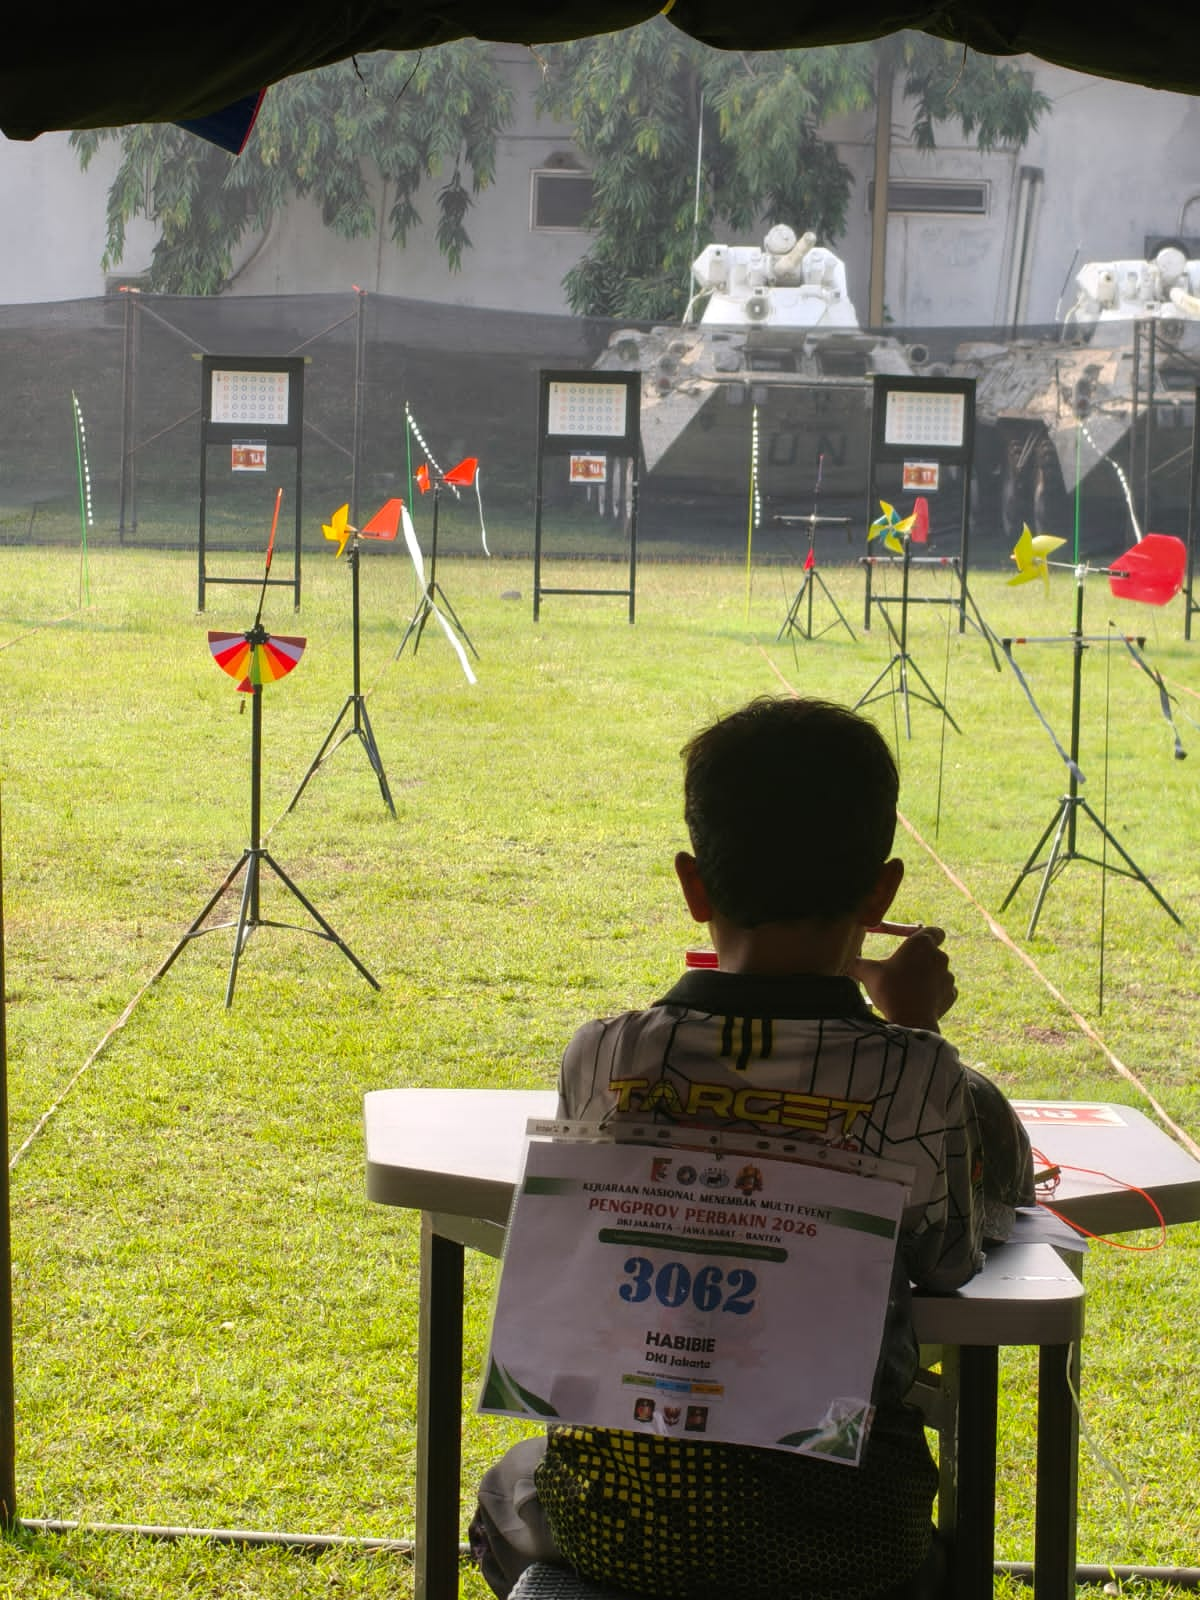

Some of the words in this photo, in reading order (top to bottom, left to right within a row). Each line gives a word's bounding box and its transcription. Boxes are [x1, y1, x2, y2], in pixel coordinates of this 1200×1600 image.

[768, 431, 848, 466] UN
[608, 1078, 873, 1133] TARGET
[583, 1182, 639, 1196] KEJUARAAN
[641, 1185, 697, 1203] NASIONAL
[699, 1194, 757, 1209] MENEMBAK
[760, 1200, 794, 1214] MULTI
[797, 1206, 832, 1221] EVENT
[588, 1197, 680, 1219] PENGPROV
[685, 1207, 767, 1229] PERBAKIN
[771, 1216, 818, 1237] 2026
[633, 1219, 673, 1232] JAKARTA
[682, 1225, 706, 1237] JAWA
[707, 1228, 736, 1239] BARAT
[745, 1231, 782, 1243] BANTEN
[618, 1256, 758, 1315] 3062
[645, 1331, 717, 1353] HABIBIE
[645, 1351, 667, 1364] DKI
[669, 1355, 711, 1369] Jakarta
